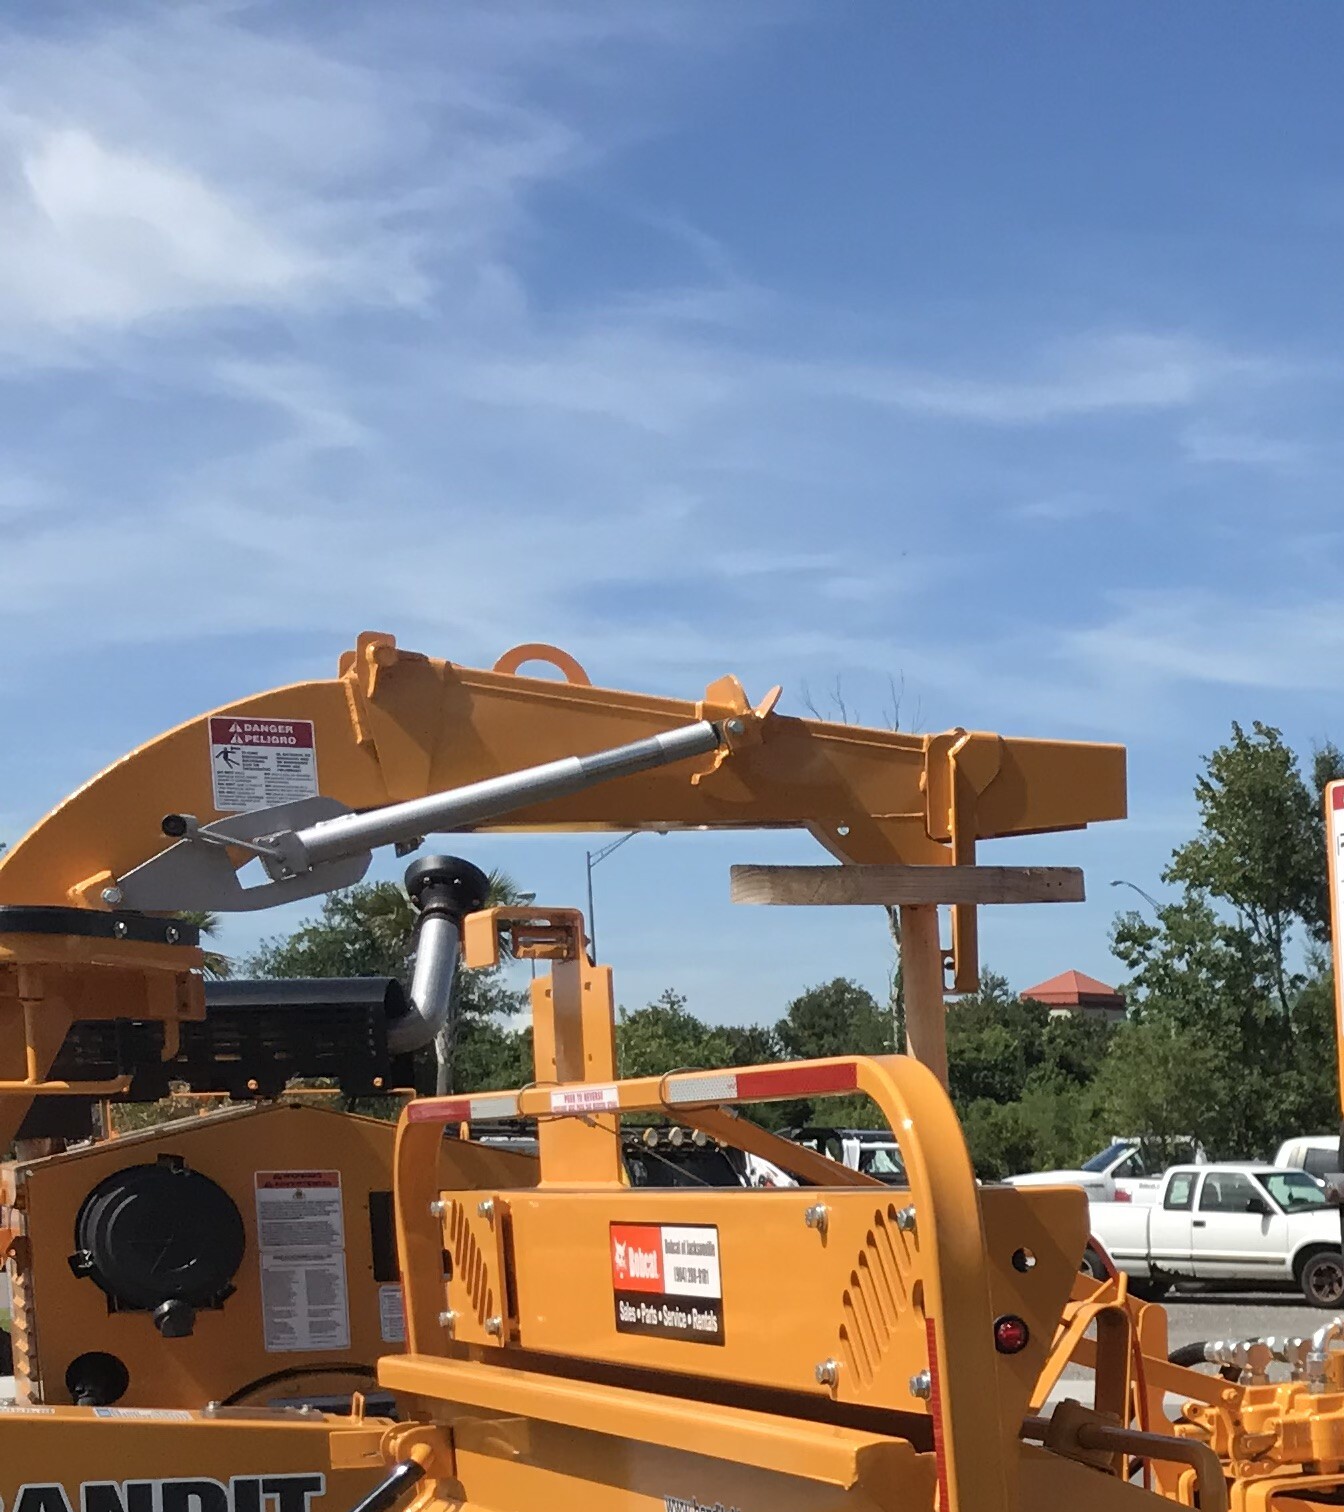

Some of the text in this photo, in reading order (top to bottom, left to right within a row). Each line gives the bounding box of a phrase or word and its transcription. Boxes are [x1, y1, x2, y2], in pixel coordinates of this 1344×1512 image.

[244, 724, 293, 733] DANGER
[245, 735, 296, 745] PELIGRO
[628, 1247, 659, 1278] Bobcat
[620, 1300, 717, 1332] Sales Parts Service Rentals
